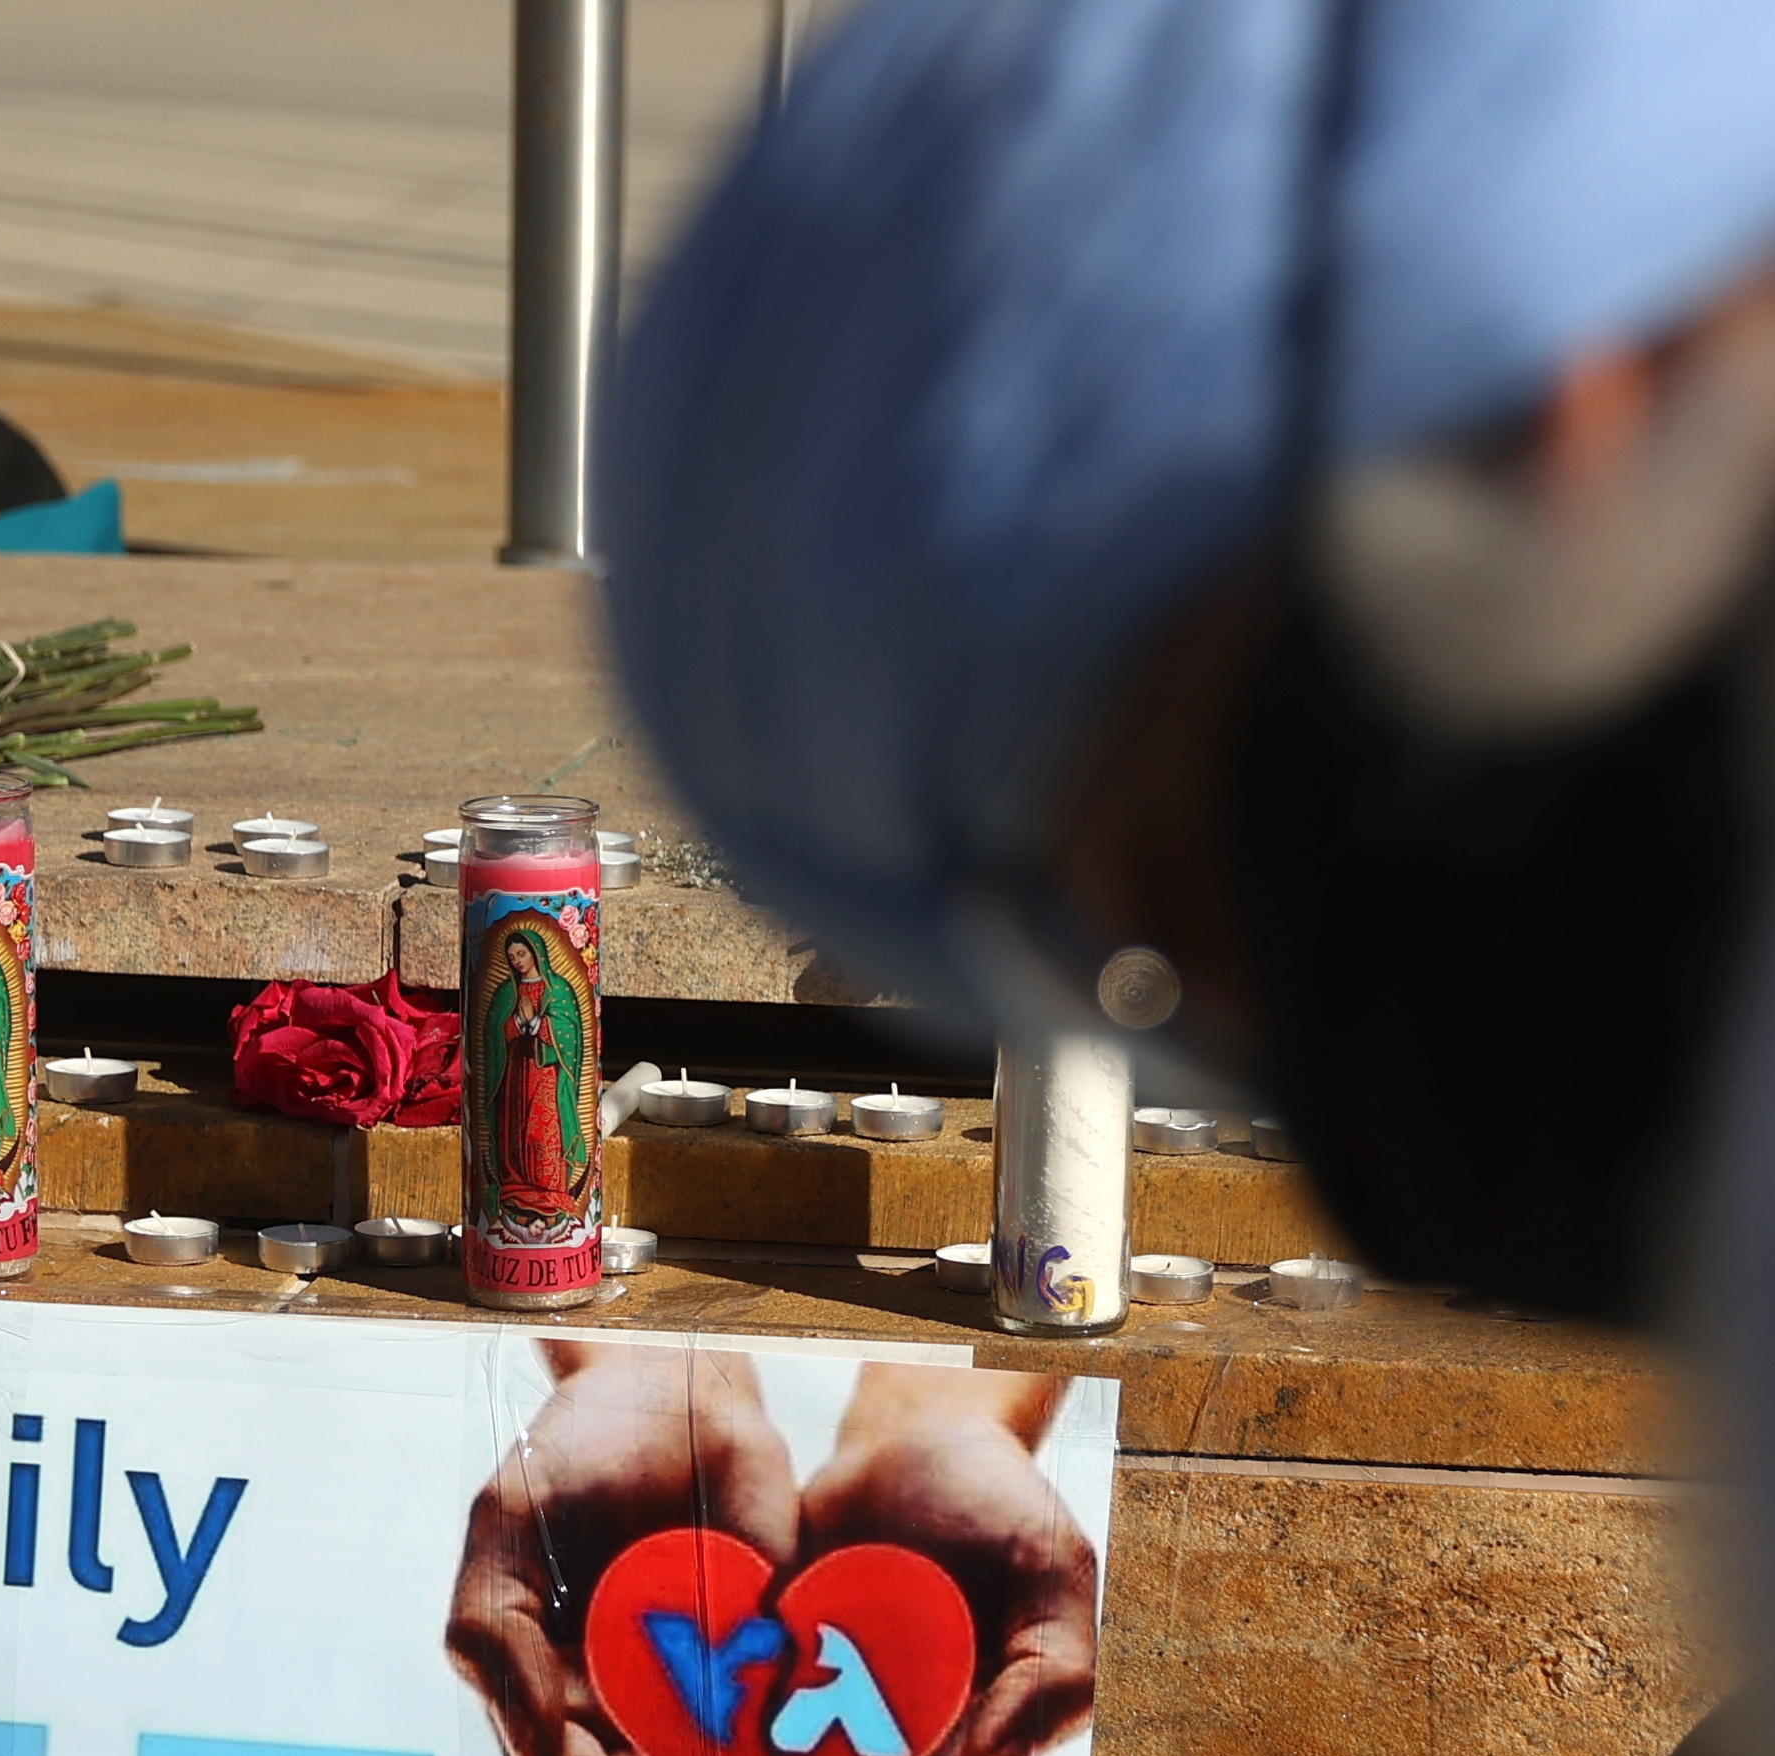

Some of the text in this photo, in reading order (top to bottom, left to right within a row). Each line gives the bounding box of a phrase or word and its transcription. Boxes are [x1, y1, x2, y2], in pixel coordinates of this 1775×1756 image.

[479, 1251, 520, 1286] LUZ
[526, 1258, 559, 1287] DE
[562, 1251, 587, 1284] TU
